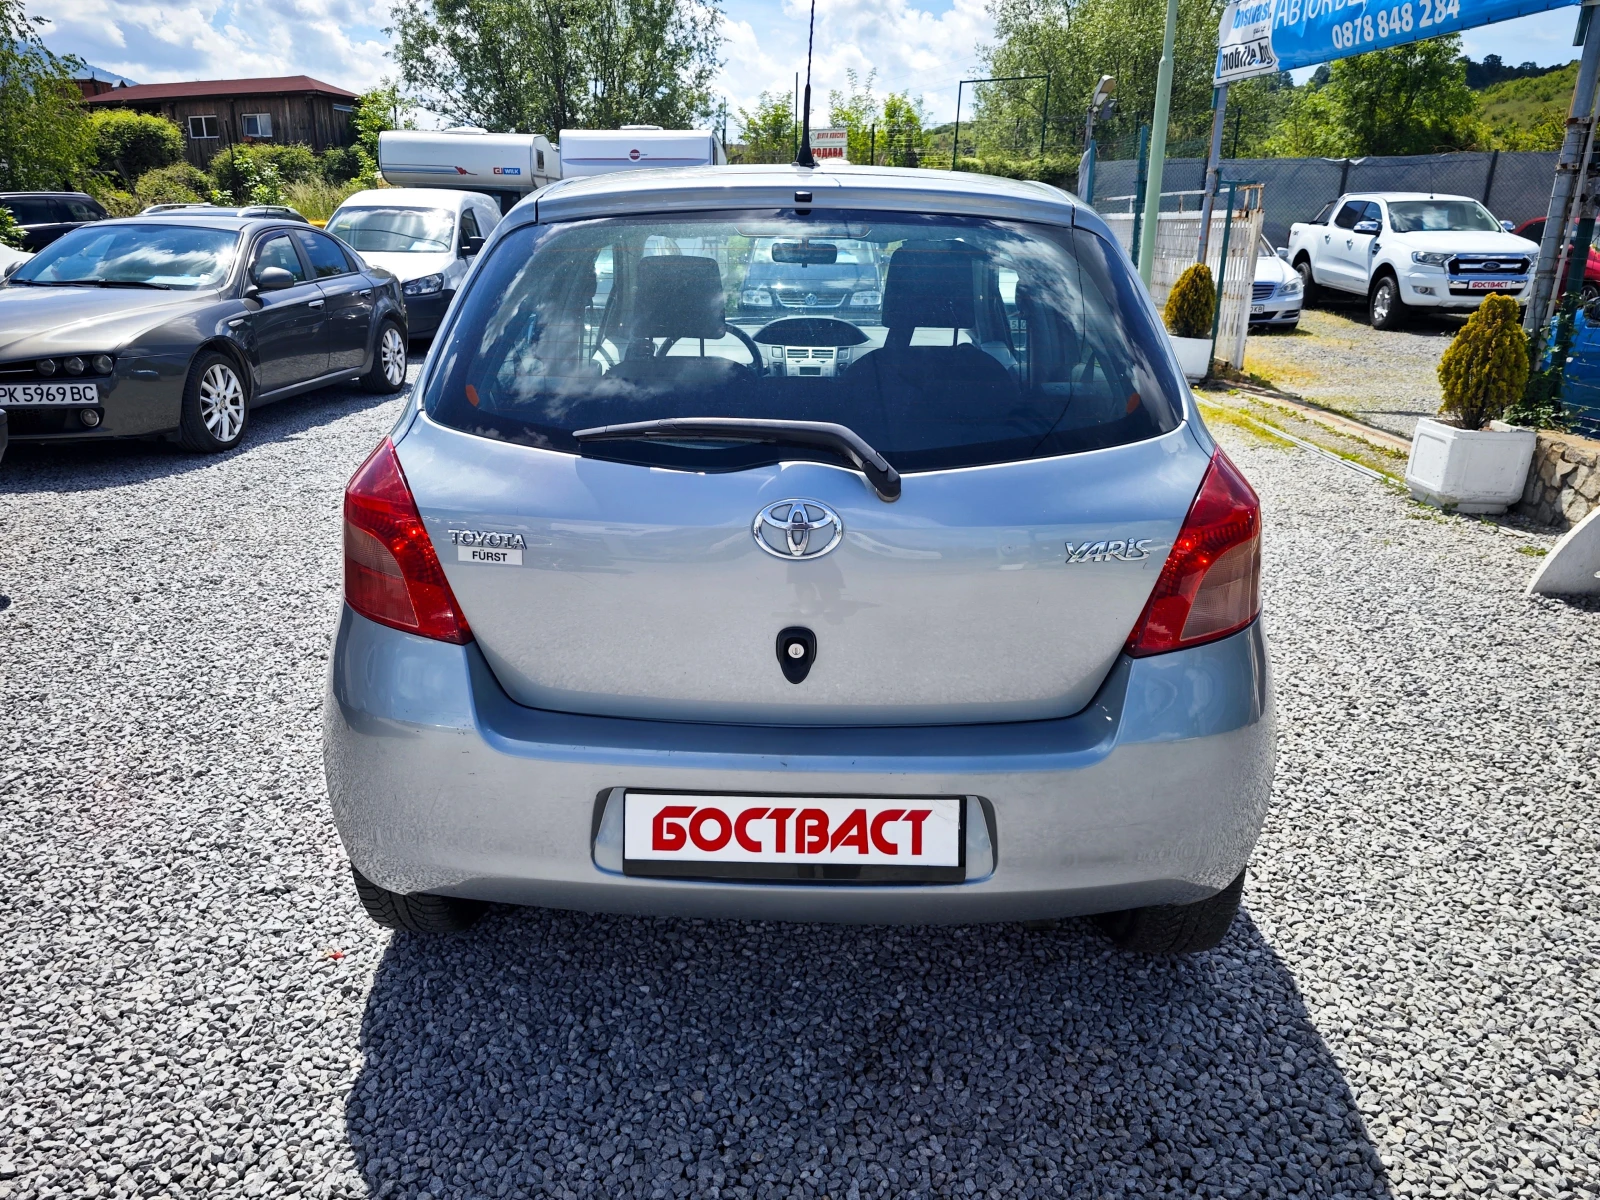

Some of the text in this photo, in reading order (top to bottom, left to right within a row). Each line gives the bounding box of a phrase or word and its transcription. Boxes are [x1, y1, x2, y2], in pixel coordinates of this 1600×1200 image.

[1332, 0, 1460, 49] 0878 848 284
[1221, 42, 1273, 71] mobile.bg
[811, 147, 843, 158] РОДАВА
[22, 386, 67, 402] 5969
[70, 386, 95, 401] BC
[447, 529, 528, 550] TOYOTA
[472, 549, 508, 562] FÜRST
[652, 805, 932, 856] БОСТВАСТ
